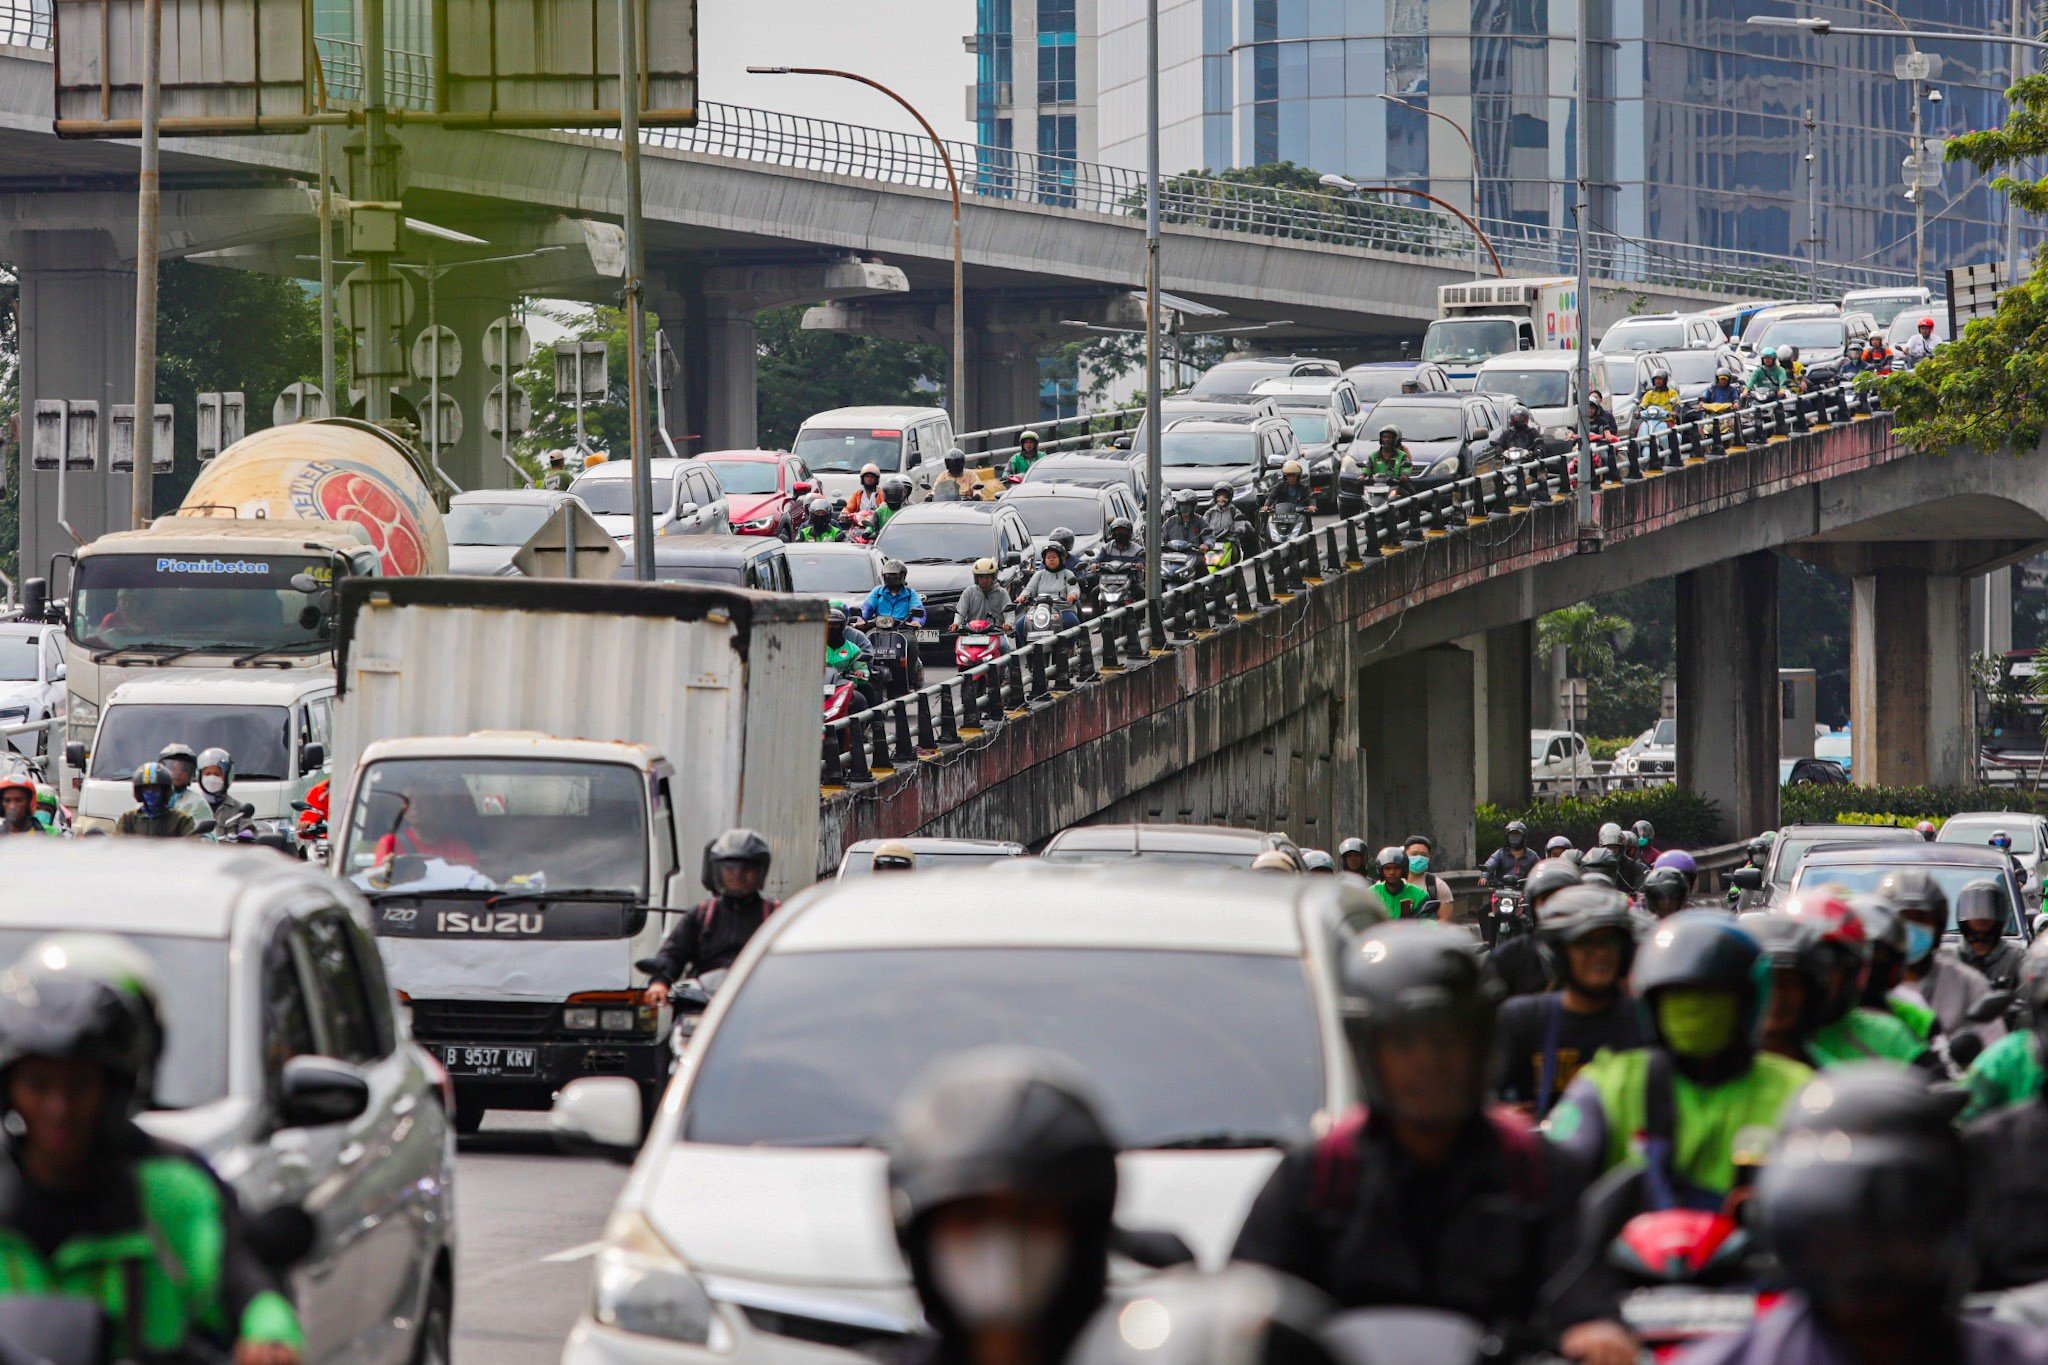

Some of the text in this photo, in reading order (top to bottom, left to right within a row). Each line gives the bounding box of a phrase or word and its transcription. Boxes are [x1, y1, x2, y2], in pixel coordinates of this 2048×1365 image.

[156, 557, 269, 574] Pionirbeton
[926, 630, 939, 639] TYK
[437, 912, 543, 934] ISUZU
[447, 1048, 533, 1067] B 9537 KRV
